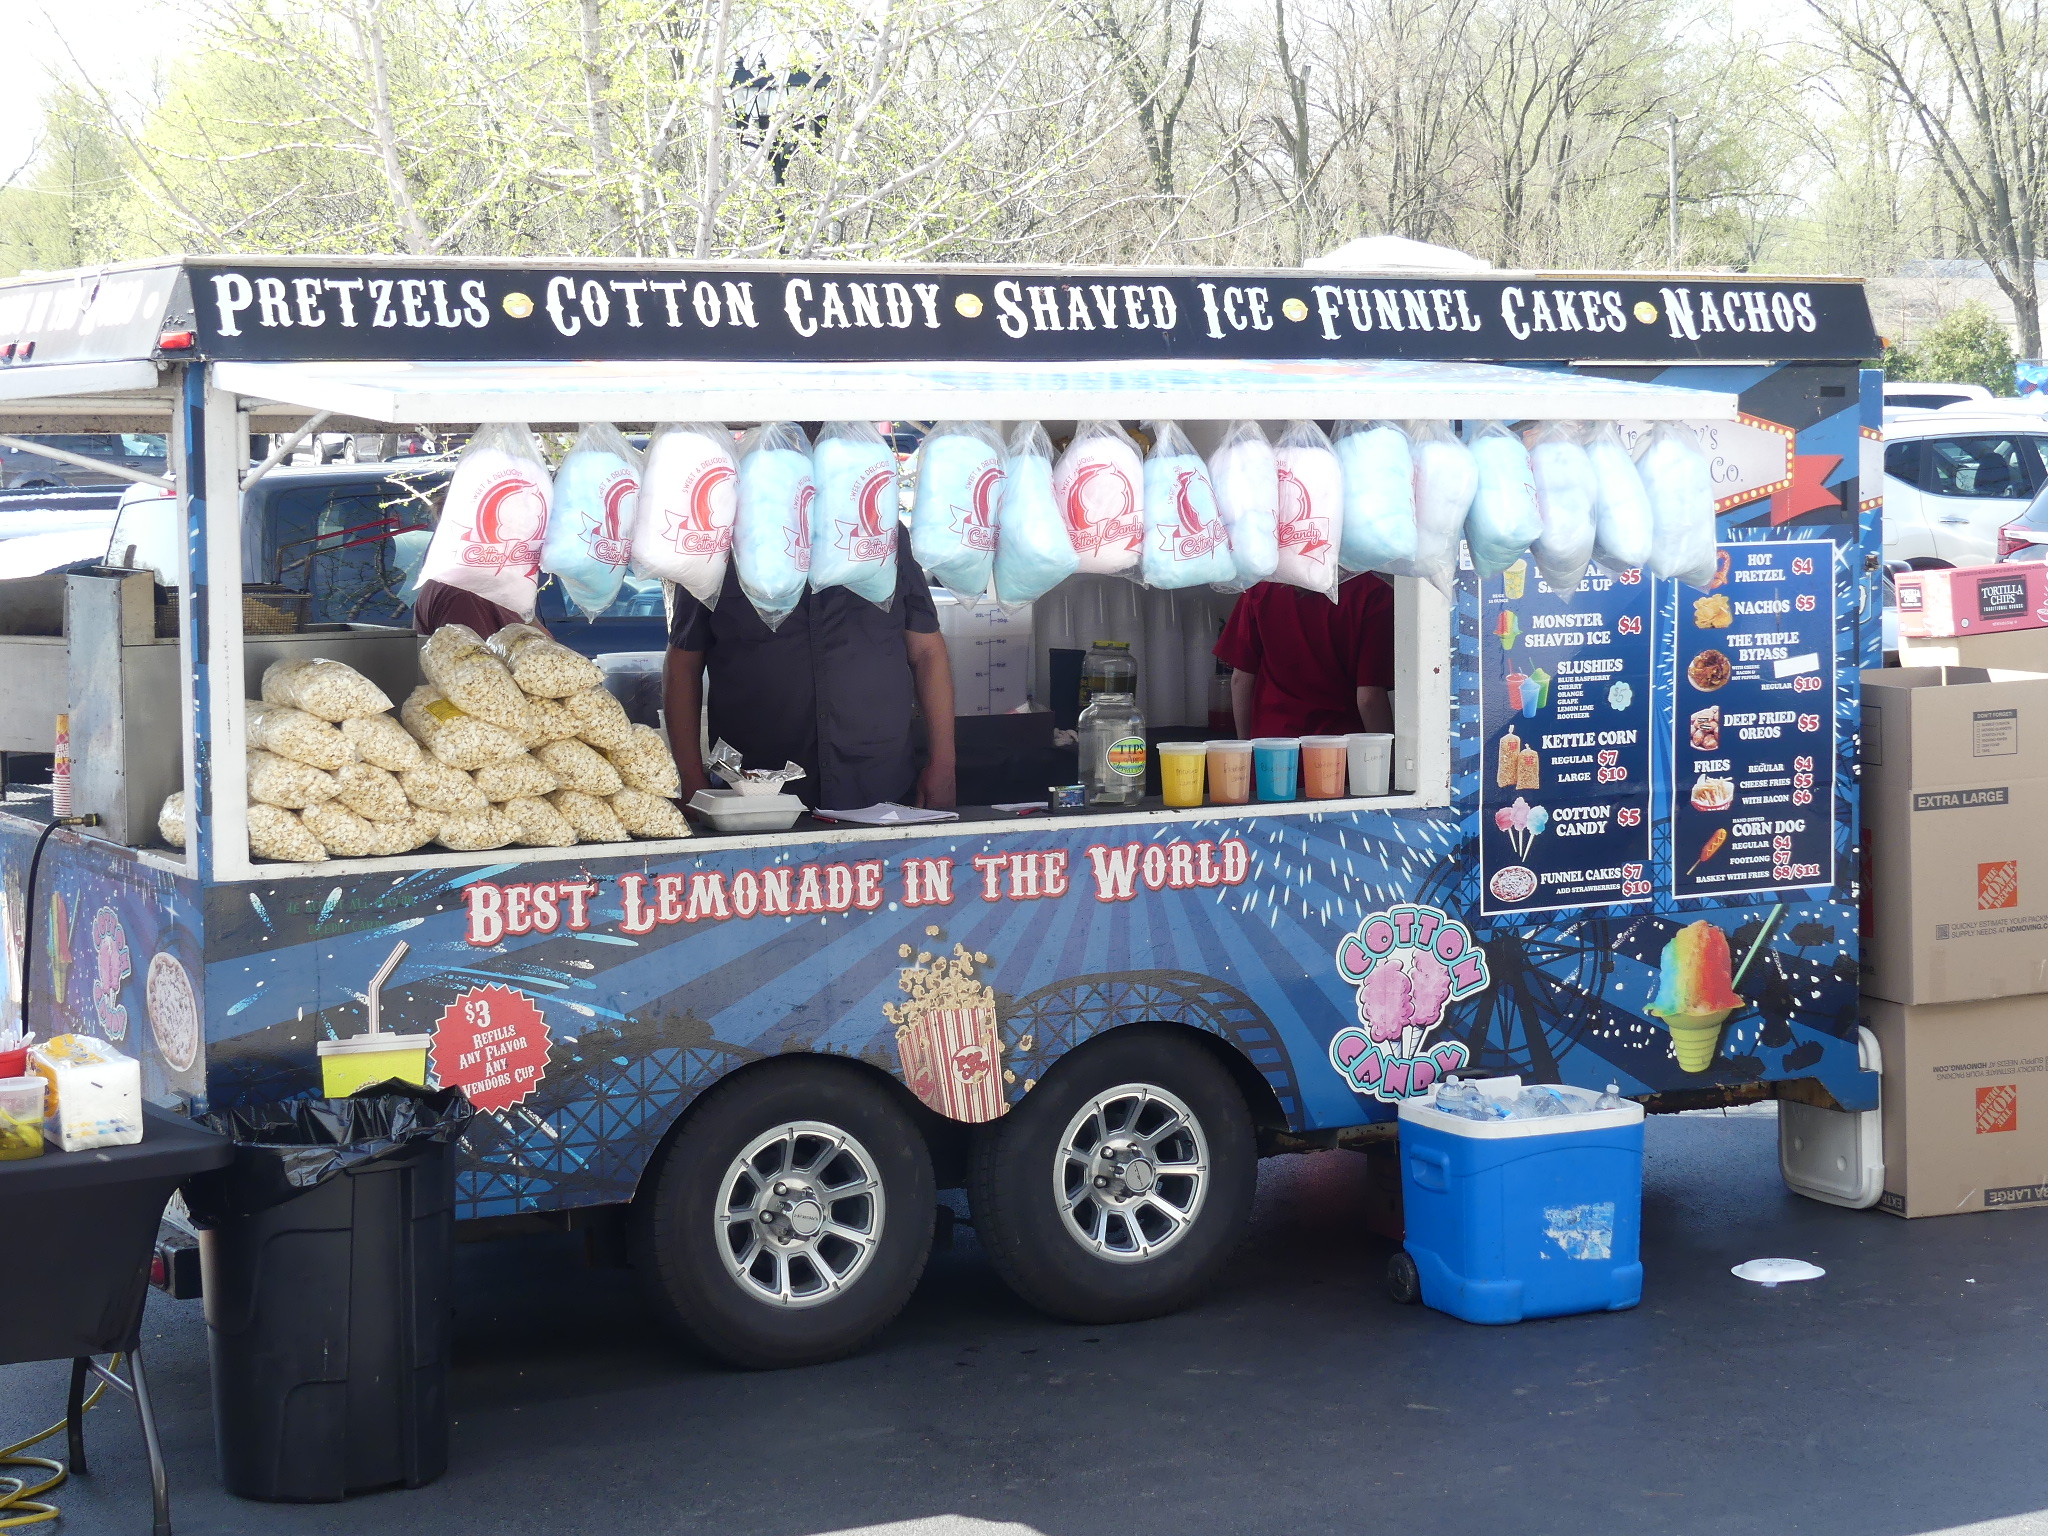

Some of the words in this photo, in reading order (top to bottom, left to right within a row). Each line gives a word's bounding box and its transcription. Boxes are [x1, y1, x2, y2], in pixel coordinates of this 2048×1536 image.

[210, 273, 488, 337] PRETZELS
[546, 276, 759, 336] COTTON
[784, 278, 941, 338] CANDY
[994, 281, 1178, 338] SHAVED
[1197, 283, 1273, 339] ICE
[1311, 284, 1481, 340] FUNNEL
[1501, 286, 1627, 340] CAKES
[1661, 288, 1816, 340] NACHOS
[1710, 456, 1744, 483] Co.
[1104, 515, 1144, 540] Candy
[1280, 523, 1321, 545] Candy
[682, 533, 716, 552] Cotton
[856, 539, 888, 559] Cotton
[462, 544, 506, 564] Cotton
[509, 543, 543, 563] Cand
[1748, 554, 1772, 565] HOT
[1792, 557, 1812, 575] $4
[1620, 569, 1641, 584] $5
[1735, 570, 1785, 583] PRETZEL
[1593, 580, 1612, 591] UP
[1981, 584, 2023, 599] TORTILLA
[1734, 600, 1790, 615] NACHOS
[1796, 594, 1815, 611] $5
[1990, 594, 2016, 605] CHIPS
[1533, 613, 1603, 629] MONSTER
[1619, 616, 1641, 635] $4
[1525, 633, 1584, 647] SHAVED
[1587, 631, 1611, 645] ICE
[1727, 634, 1752, 647] THE
[1755, 632, 1799, 646] TRIPLE
[1739, 647, 1787, 661] BYPASS
[1557, 659, 1623, 674] SLUSHIES
[1794, 678, 1821, 692] $10
[1724, 714, 1756, 726] DEEP
[1758, 711, 1795, 724] FRIED
[1798, 715, 1818, 731] $5
[1542, 732, 1596, 749] KETTLE
[1598, 730, 1637, 745] CORN
[1739, 727, 1781, 739] OREOS
[1117, 744, 1144, 754] TIPS
[1552, 755, 1593, 765] REGULAR
[1598, 751, 1617, 766] $7
[1694, 760, 1730, 772] FRIES
[1749, 764, 1784, 773] REGULAR
[1795, 756, 1812, 771] $4
[1558, 773, 1591, 782] LARGE
[1598, 767, 1626, 783] $10
[1740, 780, 1768, 788] CHEESE
[1795, 773, 1812, 788] $5
[1763, 795, 1789, 803] BACON
[1793, 790, 1811, 805] $6
[1918, 793, 1960, 808] EXTRA
[1962, 790, 2004, 805] LARGE
[1553, 806, 1611, 821] COTTON
[1618, 808, 1640, 826] $5
[1556, 821, 1607, 836] CANDY
[1732, 822, 1772, 836] CORN
[1775, 820, 1805, 833] DOG
[1732, 841, 1769, 850] REGULAR
[1773, 836, 1790, 849] $4
[1730, 855, 1770, 864] FOOTLONG
[1773, 851, 1790, 864] $7
[1541, 871, 1584, 884] FUNNEL
[1585, 868, 1622, 881] CAKES
[1623, 864, 1642, 880] $7
[1696, 874, 1726, 883] BASKET
[1727, 872, 1747, 880] WITH
[1748, 871, 1769, 879] FRIES
[1773, 864, 1820, 880] $8/$11
[1981, 867, 1999, 886] THE
[464, 881, 595, 946] BEST
[619, 860, 883, 934] LEMONADE
[903, 857, 954, 906] IN
[974, 850, 1068, 901] THE
[1085, 839, 1250, 902] WORLD
[1572, 884, 1620, 893] STRAWBERRIES
[1622, 882, 1650, 896] $10
[1978, 861, 2017, 909] HOME
[1993, 877, 2017, 908] DEPOT
[1951, 921, 1977, 930] QUICKLY
[1979, 918, 2008, 927] ESTIMATE
[2009, 916, 2027, 925] YOUR
[1951, 930, 1976, 939] SUPPLY
[1977, 927, 1997, 935] NEEDS
[1342, 910, 1484, 993] COTTON
[465, 1000, 491, 1028] $3
[473, 1025, 516, 1049] REFILLS
[459, 1051, 481, 1070] ANY
[485, 1037, 527, 1061] FLAVOR
[2019, 1057, 2043, 1065] SUPPLY
[485, 1058, 507, 1077] ANY
[1335, 1033, 1465, 1098] CANDY
[1933, 1063, 1987, 1072] HDMOVING.COM
[1997, 1059, 2018, 1067] NEEDS
[2017, 1065, 2043, 1074] QUICKLY
[1936, 1071, 1964, 1080] PACKING
[1965, 1070, 1984, 1078] YOUR
[1986, 1067, 2015, 1076] ESTIMATE
[462, 1073, 511, 1099] VENDORS
[514, 1066, 535, 1083] CUP
[1976, 1086, 2000, 1118] DEPOT
[1976, 1085, 2016, 1133] HOME
[1995, 1107, 2013, 1127] THE
[1989, 1188, 2031, 1203] LARGE
